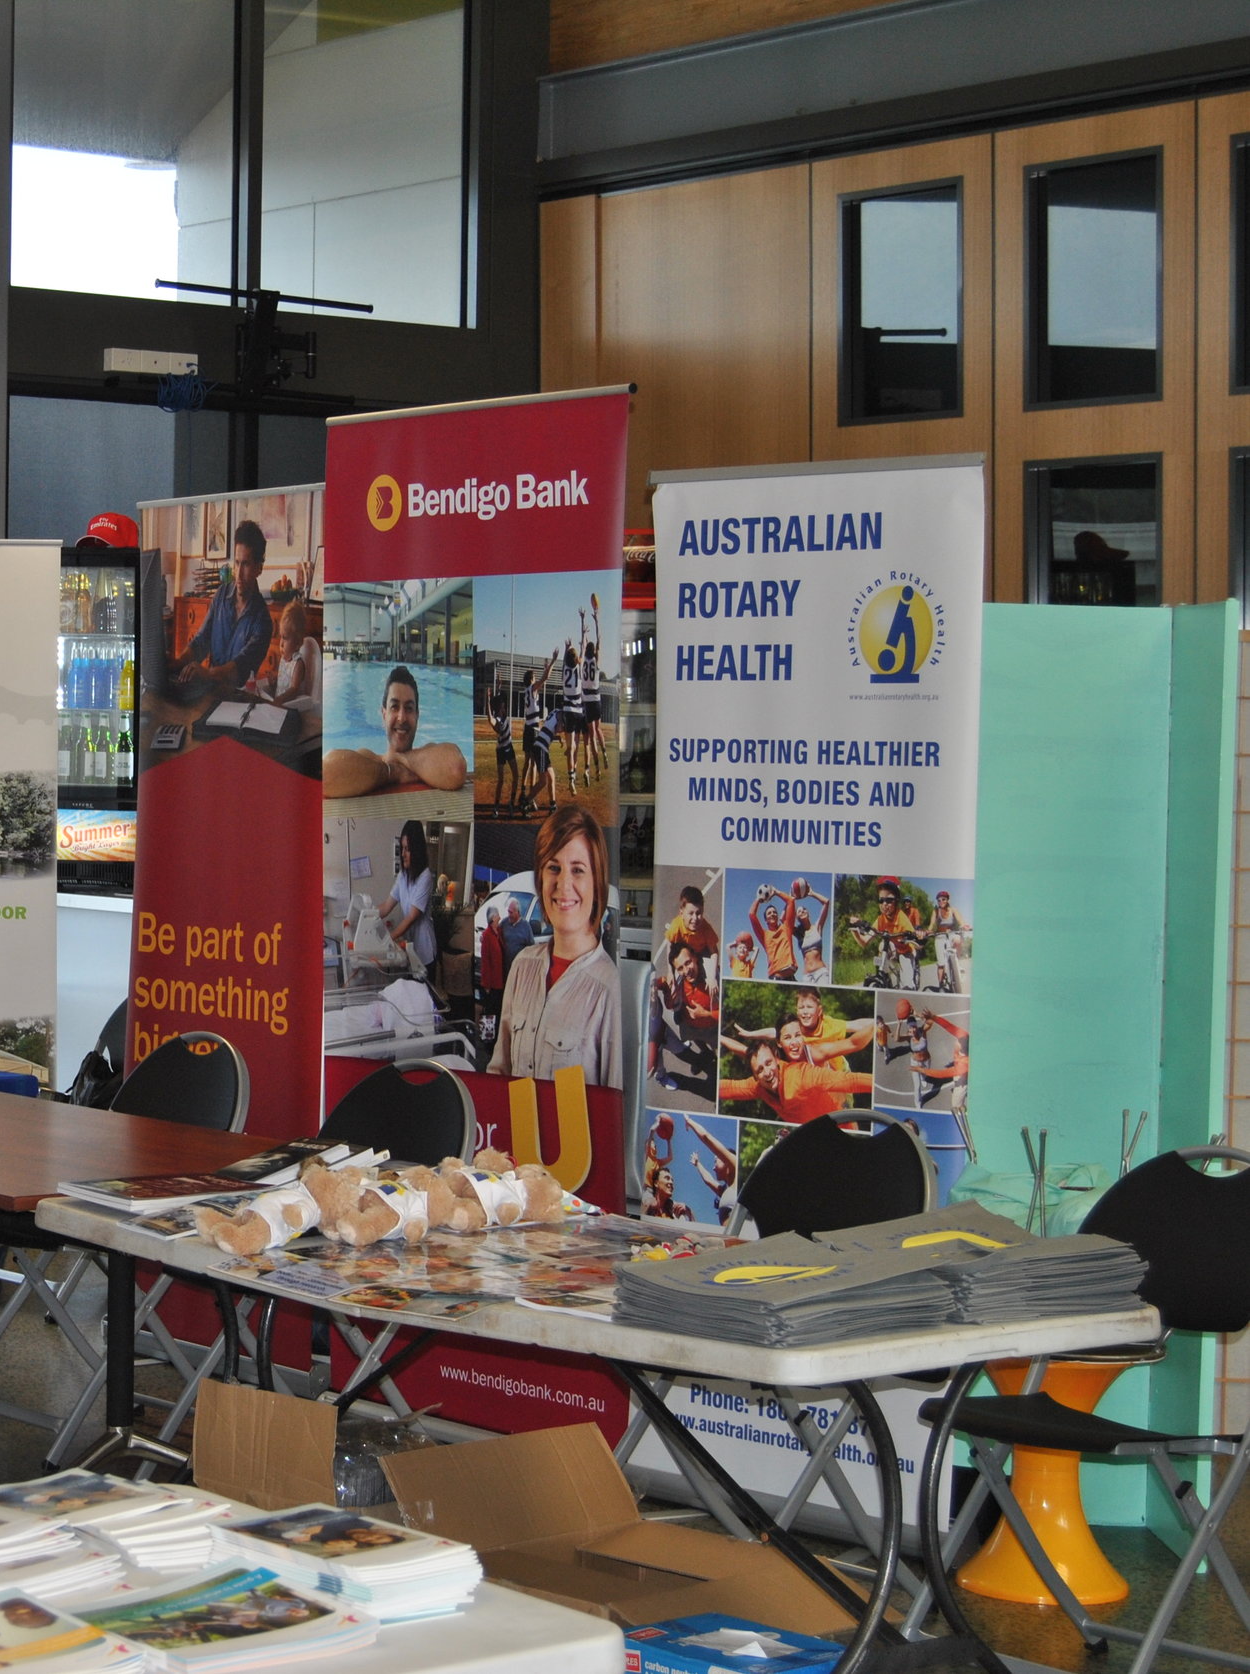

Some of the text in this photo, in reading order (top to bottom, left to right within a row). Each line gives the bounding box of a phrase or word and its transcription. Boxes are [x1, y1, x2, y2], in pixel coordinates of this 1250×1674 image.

[408, 469, 590, 521] Bendigo Bank
[678, 512, 883, 556] AUSTRALIAN
[678, 580, 801, 619] ROTARY
[847, 571, 946, 667] Australian Rotary Health
[564, 668, 579, 688] 21
[582, 660, 596, 681] 36
[676, 644, 793, 681] HEALTH
[669, 738, 940, 767] SUPPORTING HEALTHIER
[688, 777, 915, 808] MINDS, BODIES AND
[59, 824, 131, 849] Summer
[721, 816, 882, 848] COMMUNITIES
[138, 911, 282, 967] Be part of
[134, 976, 290, 1035] something
[474, 1121, 497, 1150] or
[440, 1363, 606, 1413] www.bendigobank.com.au
[690, 1382, 749, 1414] Phone:
[644, 1661, 670, 1674] carbon
